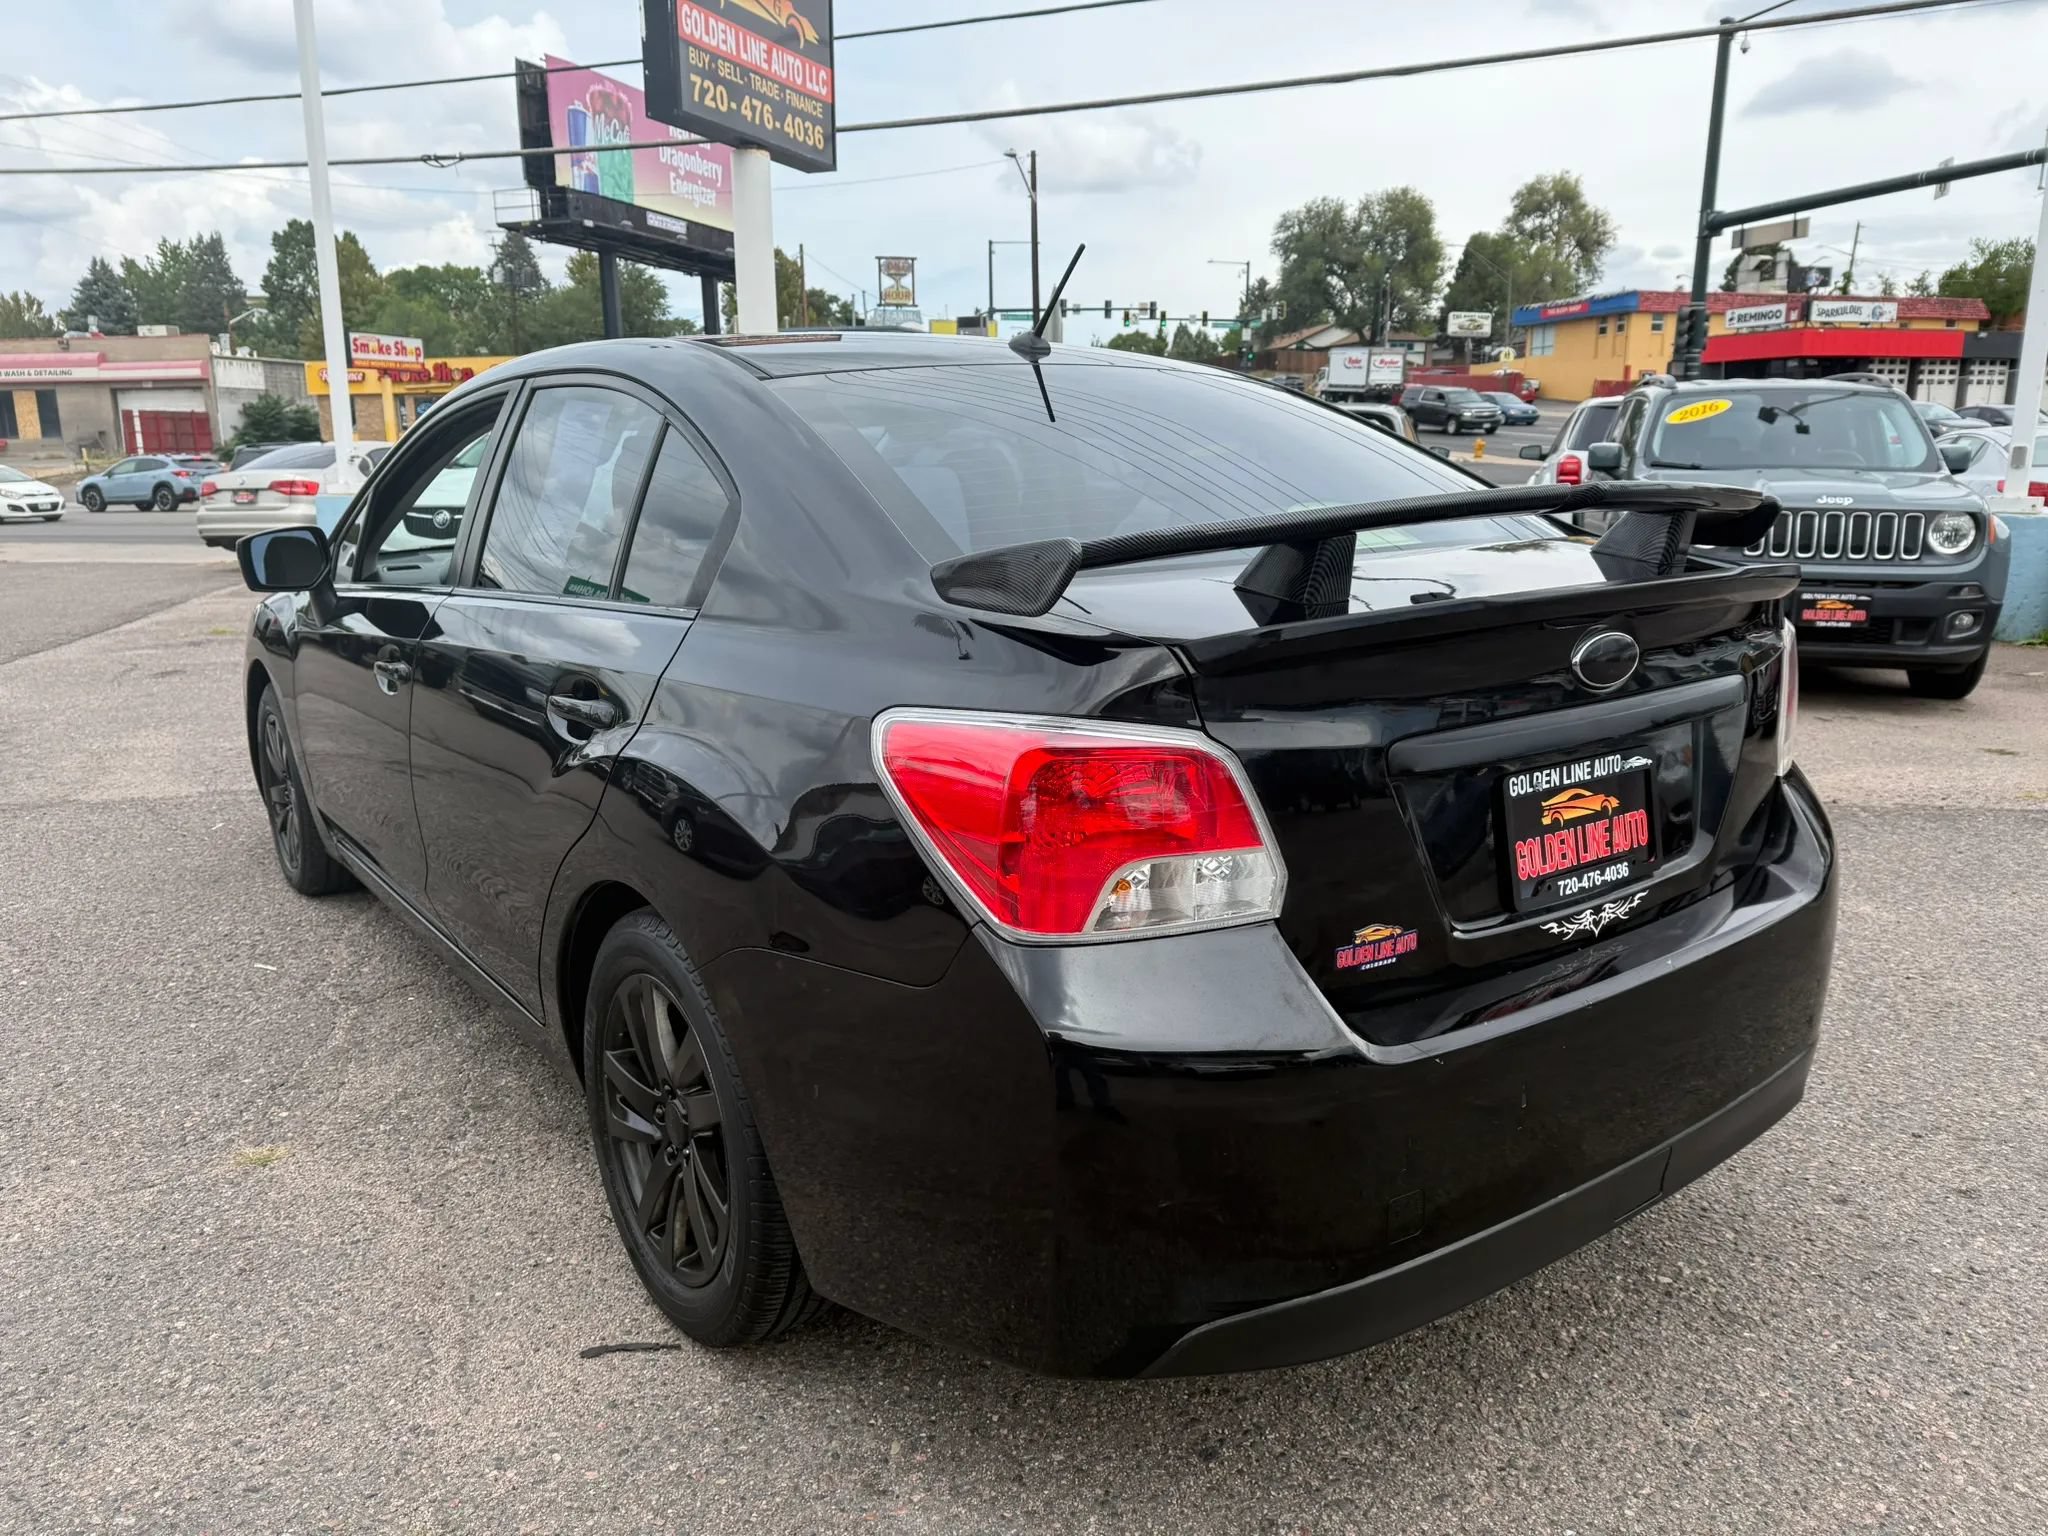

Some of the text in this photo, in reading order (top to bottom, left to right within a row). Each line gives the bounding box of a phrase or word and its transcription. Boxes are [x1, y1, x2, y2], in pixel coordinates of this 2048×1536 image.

[681, 4, 827, 96] GOLDEN LINE AUTO LLC
[688, 46, 823, 118] BUY SELL TRADE FINANCE
[659, 146, 722, 188] Dragonberry
[669, 171, 717, 208] Energizer
[1737, 308, 1782, 322] REMINGO
[1816, 305, 1863, 317] SPARKULOUS
[352, 337, 422, 360] Smoke Shop
[1679, 402, 1719, 421] 2016
[1816, 495, 1854, 506] Jeep
[1509, 754, 1621, 797] GOLDEN LINE AUTO
[1515, 809, 1649, 881] GOLDEN LINE AUTO
[1557, 861, 1629, 896] 720-476-4036
[1336, 932, 1418, 969] GOLDEN LINE AUTO
